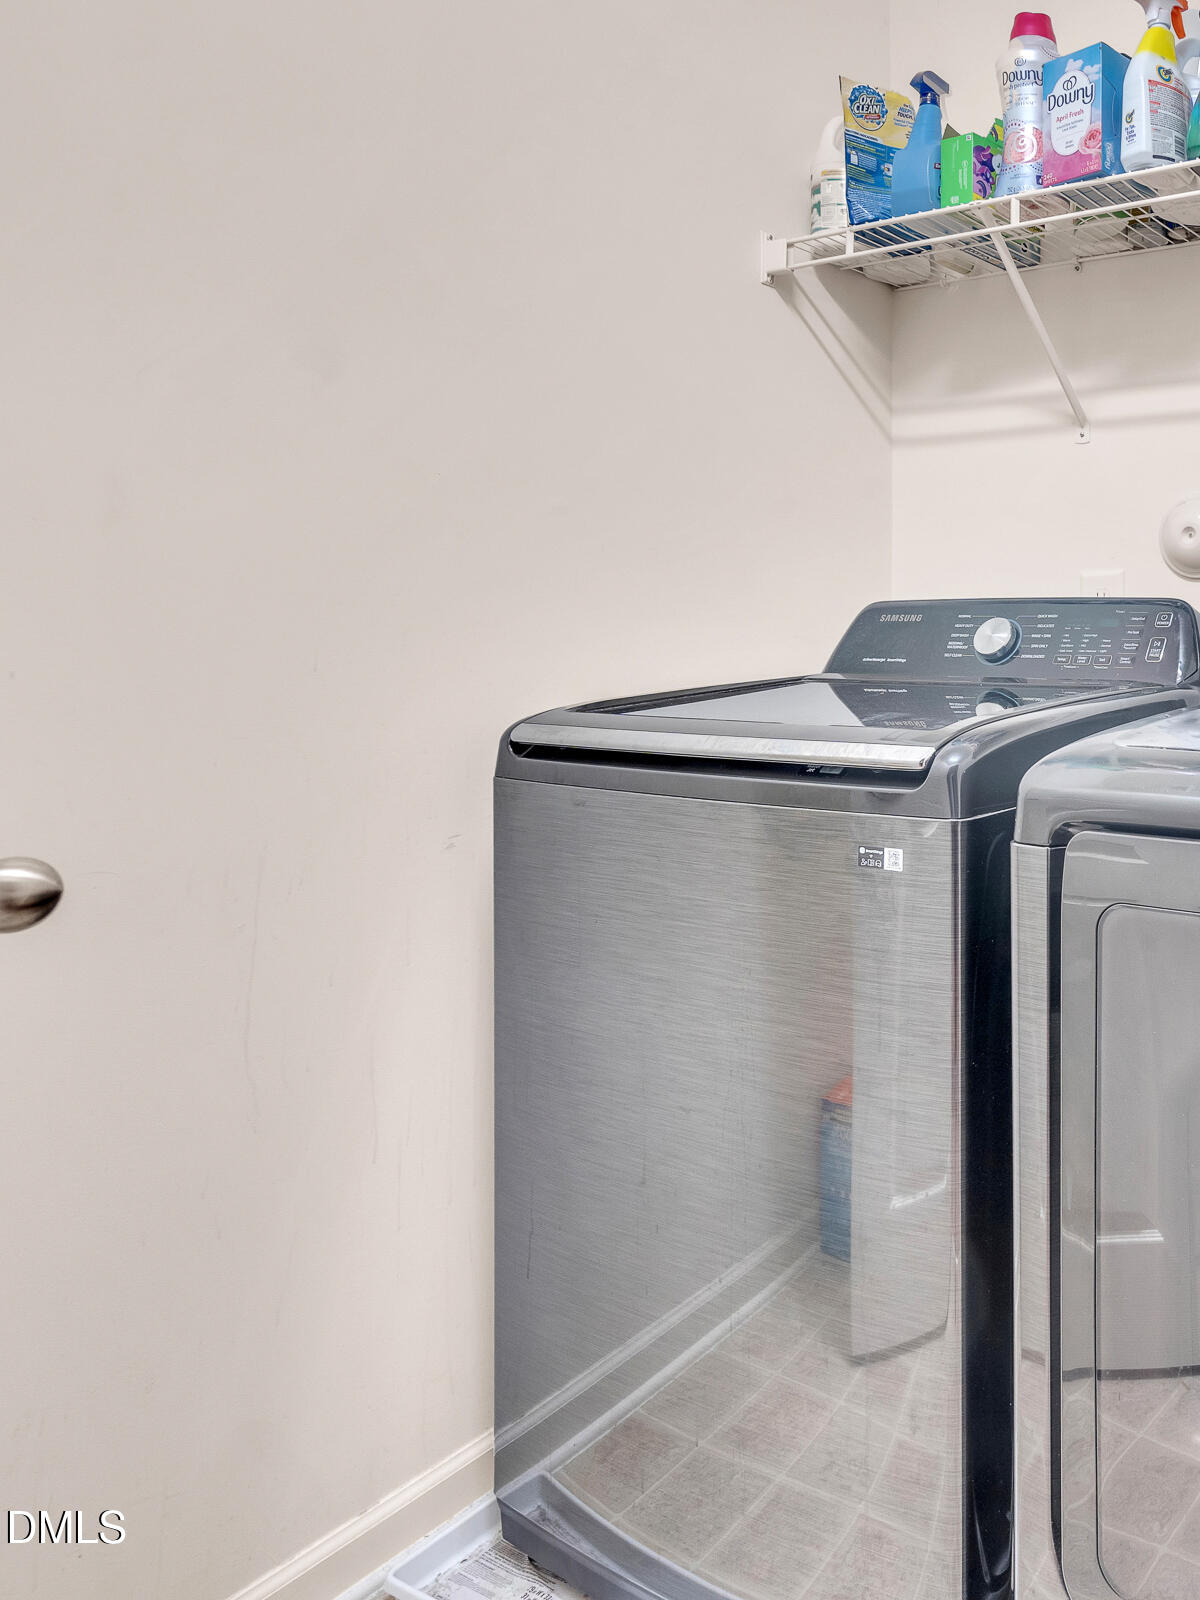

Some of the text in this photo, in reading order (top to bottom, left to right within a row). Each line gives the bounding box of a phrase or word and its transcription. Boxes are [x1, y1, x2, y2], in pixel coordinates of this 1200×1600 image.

[1002, 69, 1043, 86] Downy
[1048, 84, 1094, 112] Downy
[854, 103, 880, 114] CLEAN
[880, 614, 923, 622] SAMSUNG
